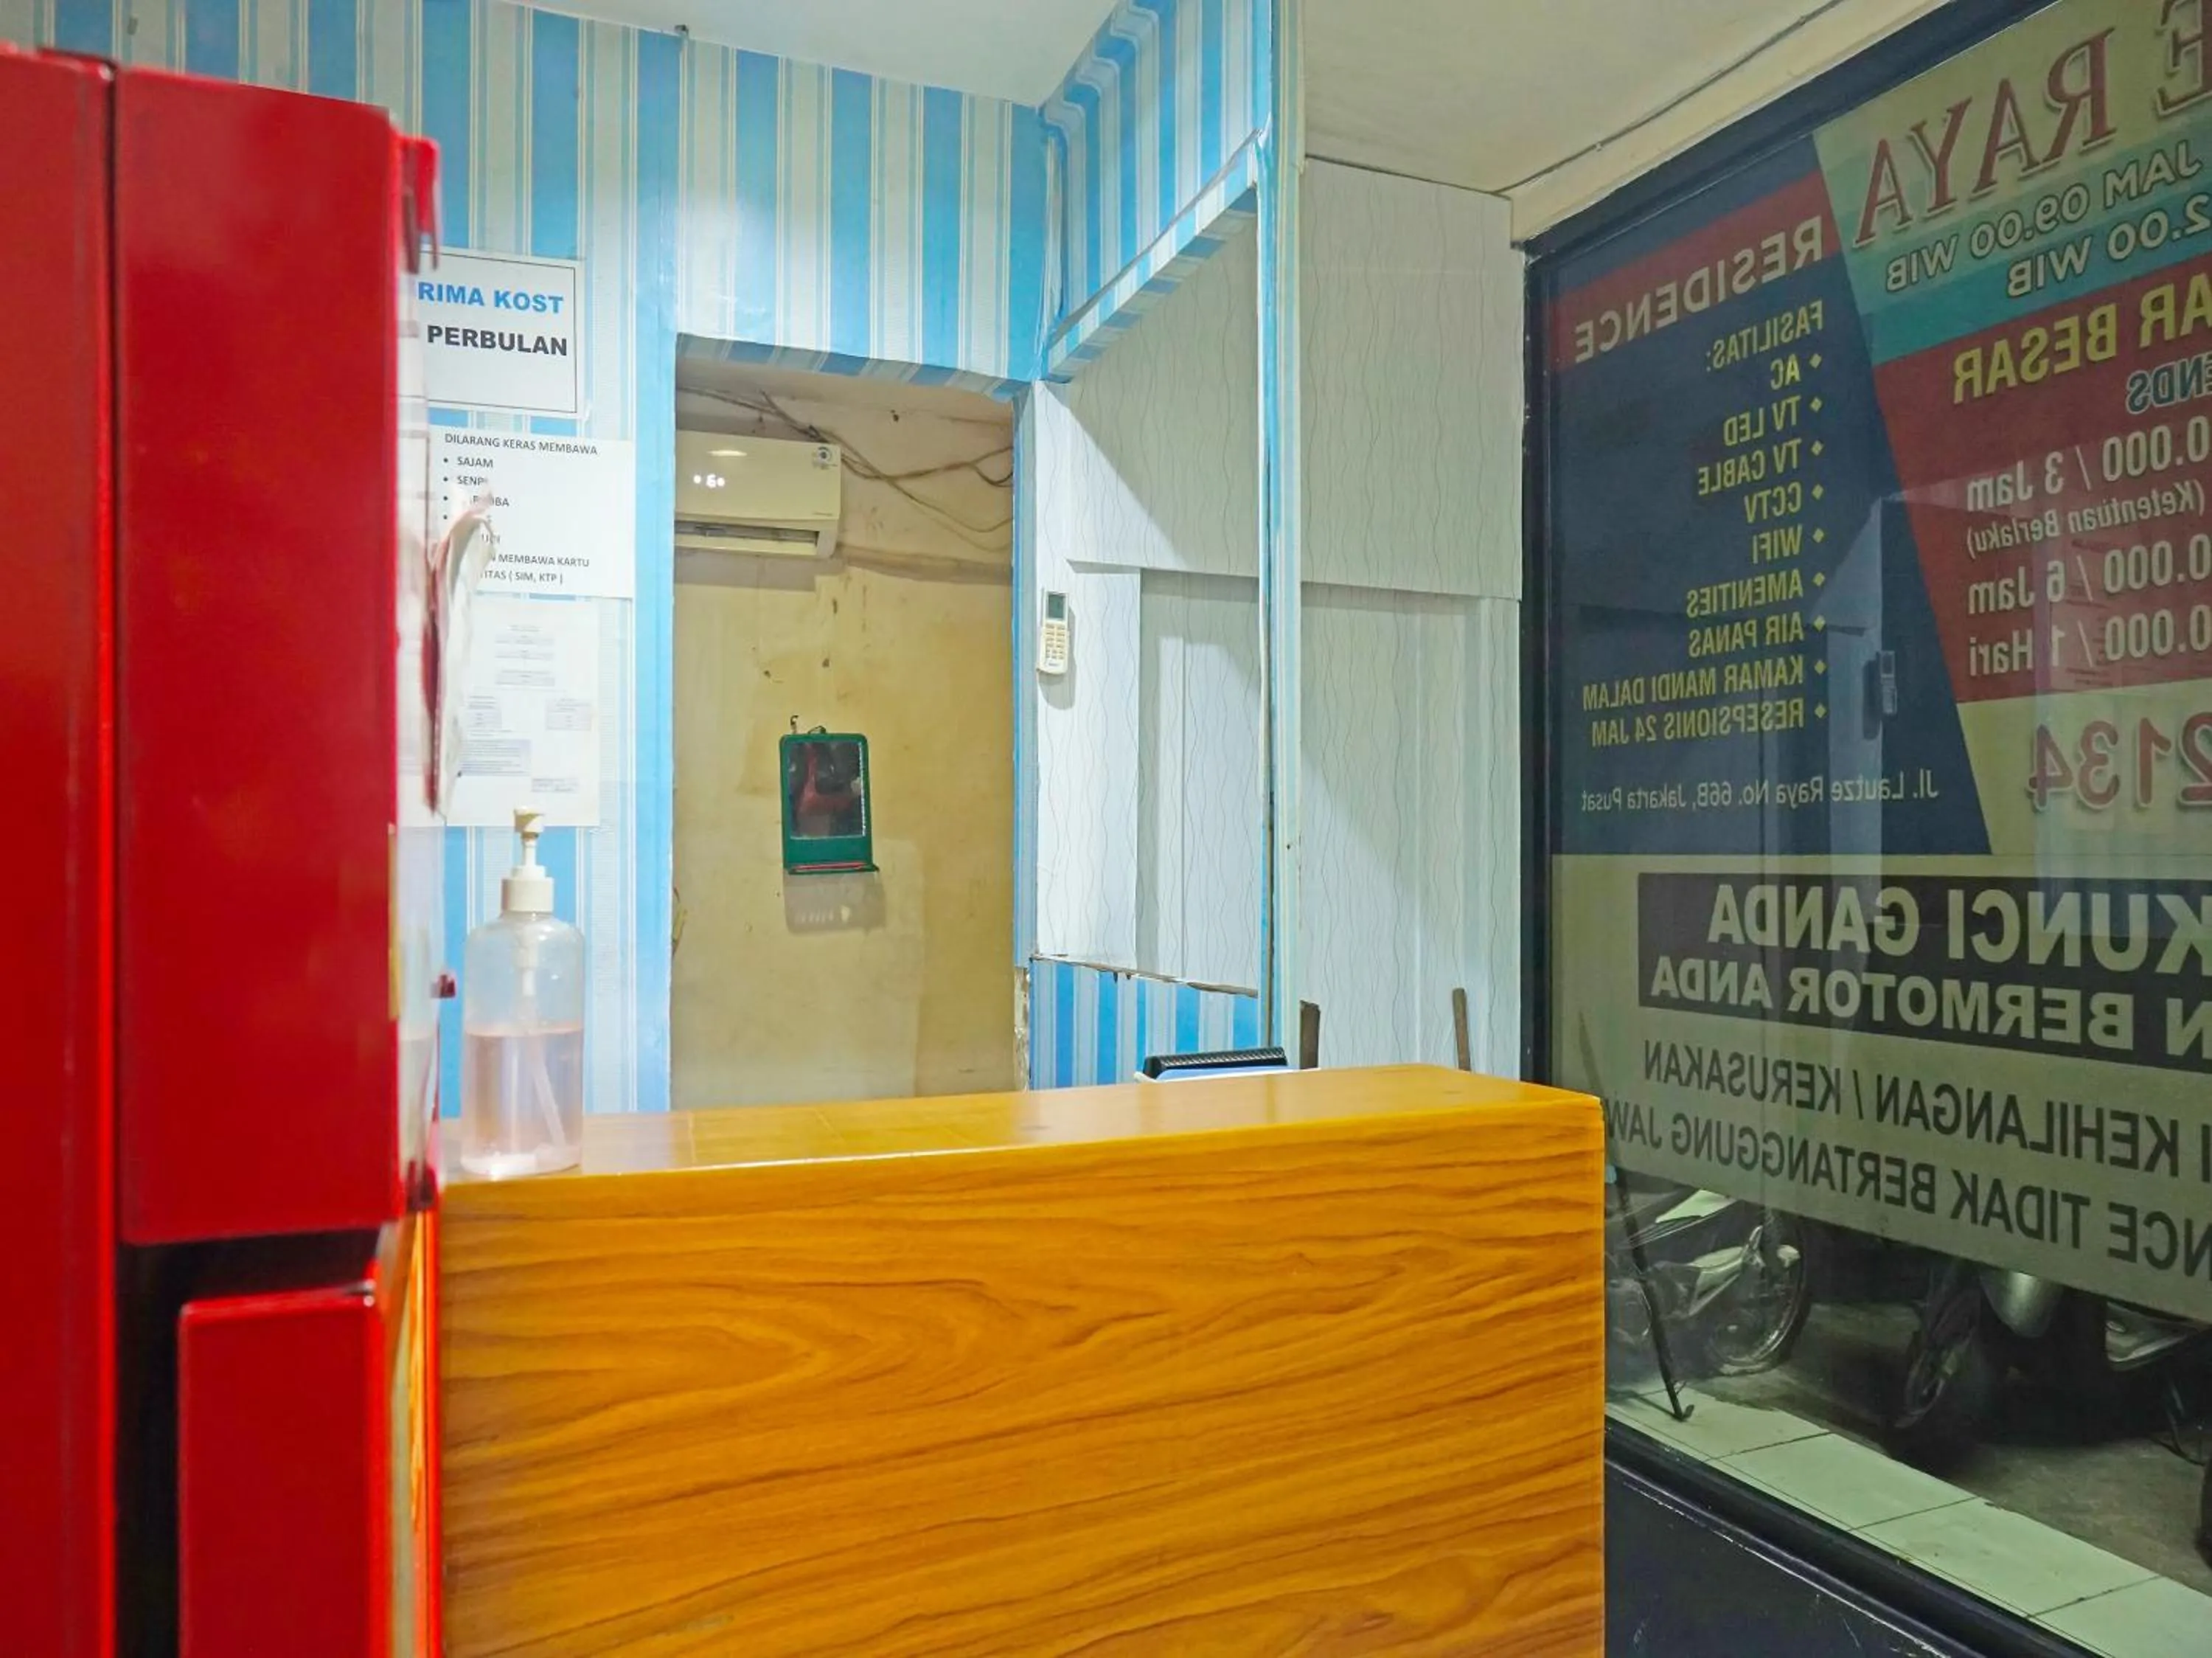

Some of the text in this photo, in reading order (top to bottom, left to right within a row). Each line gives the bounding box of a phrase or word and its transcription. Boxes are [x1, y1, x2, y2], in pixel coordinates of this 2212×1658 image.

[418, 282, 563, 313] RIMA KOST
[428, 325, 566, 355] PERBULAN
[445, 434, 598, 455] DILARANG KERAS MEMBAWA
[457, 457, 493, 468] SAJAM
[498, 554, 554, 566] MEMBAWA
[557, 558, 589, 568] KARTU
[539, 573, 557, 583] KTP
